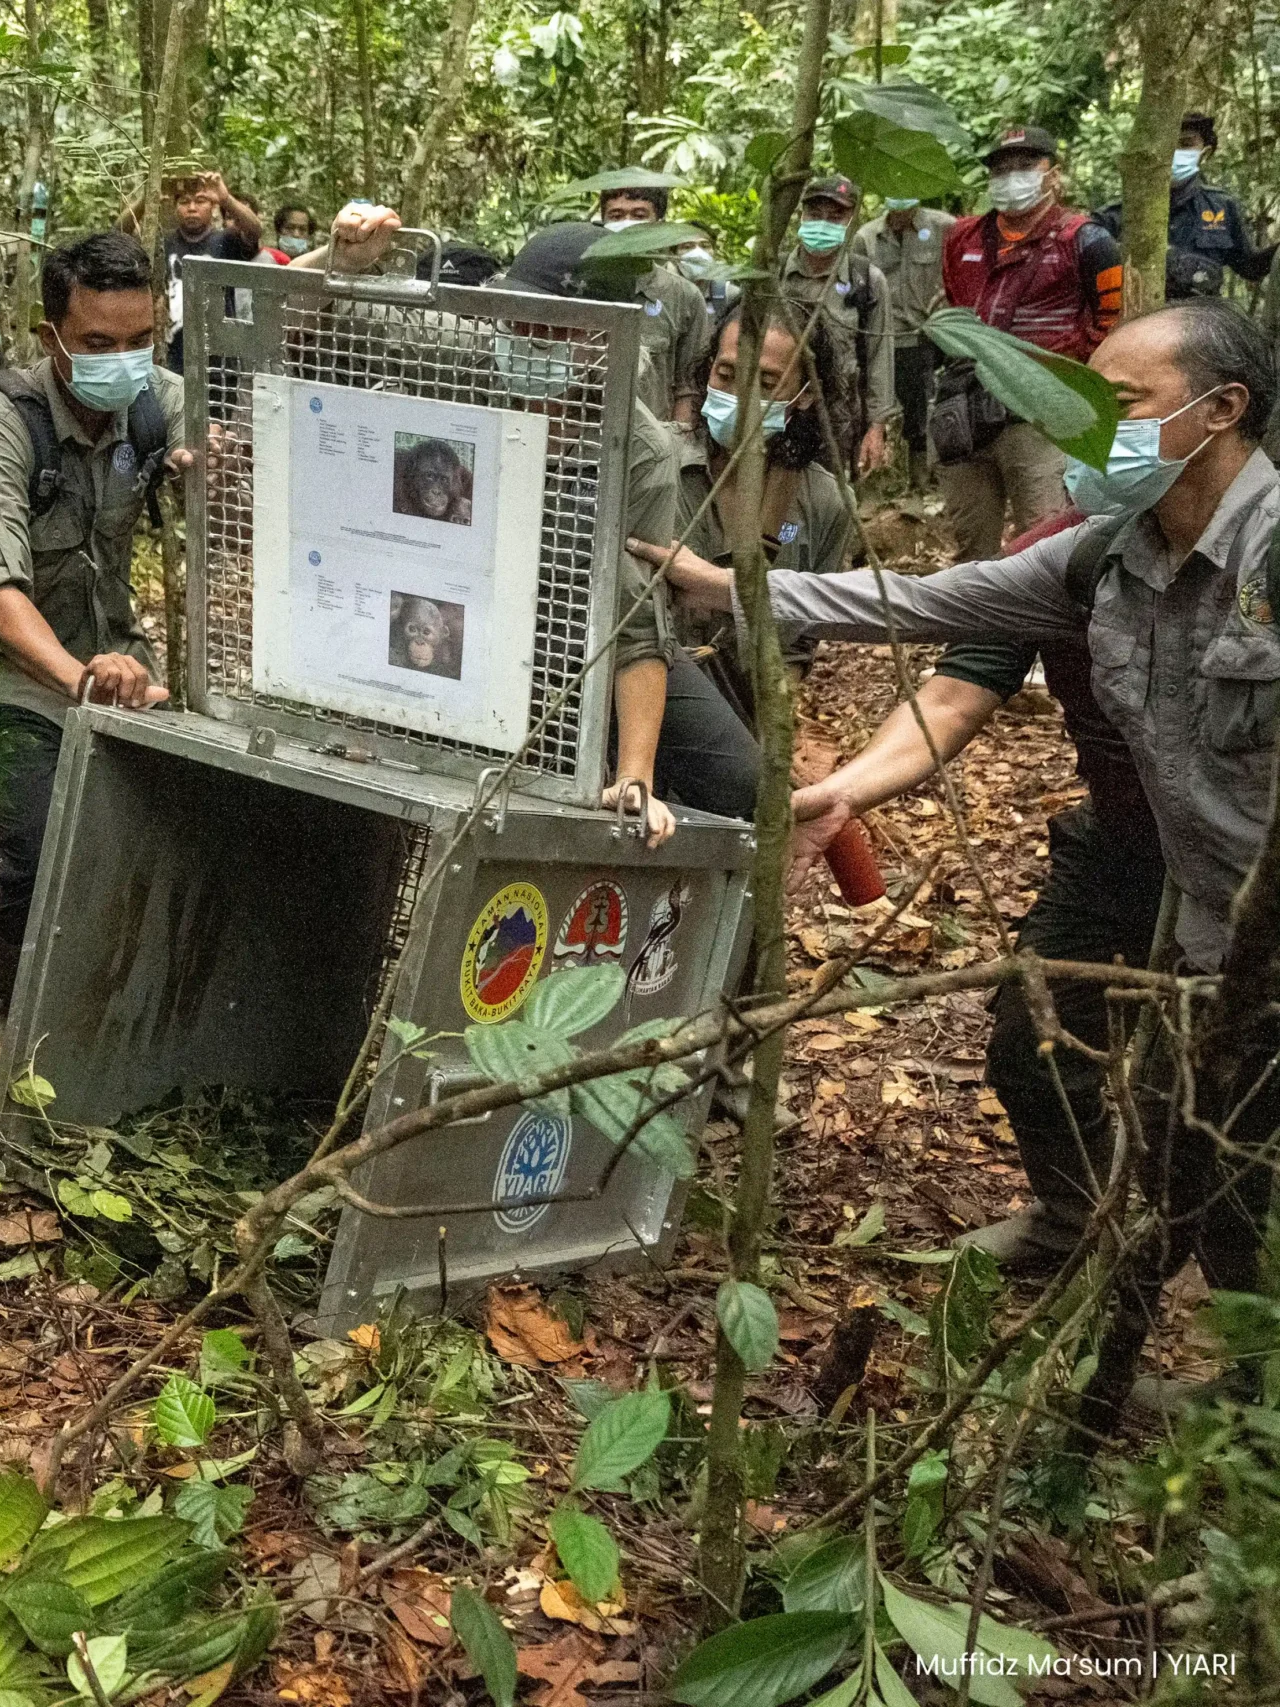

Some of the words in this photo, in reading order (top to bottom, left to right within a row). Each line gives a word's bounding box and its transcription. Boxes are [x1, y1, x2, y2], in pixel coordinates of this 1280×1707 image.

[474, 893, 510, 937] TAMAN
[513, 889, 544, 940] NASIONAL
[464, 960, 474, 1002] BUKIT
[469, 994, 519, 1018] BAKA-BUKIT
[517, 963, 539, 997] RAYA
[504, 1171, 554, 1197] YIARI
